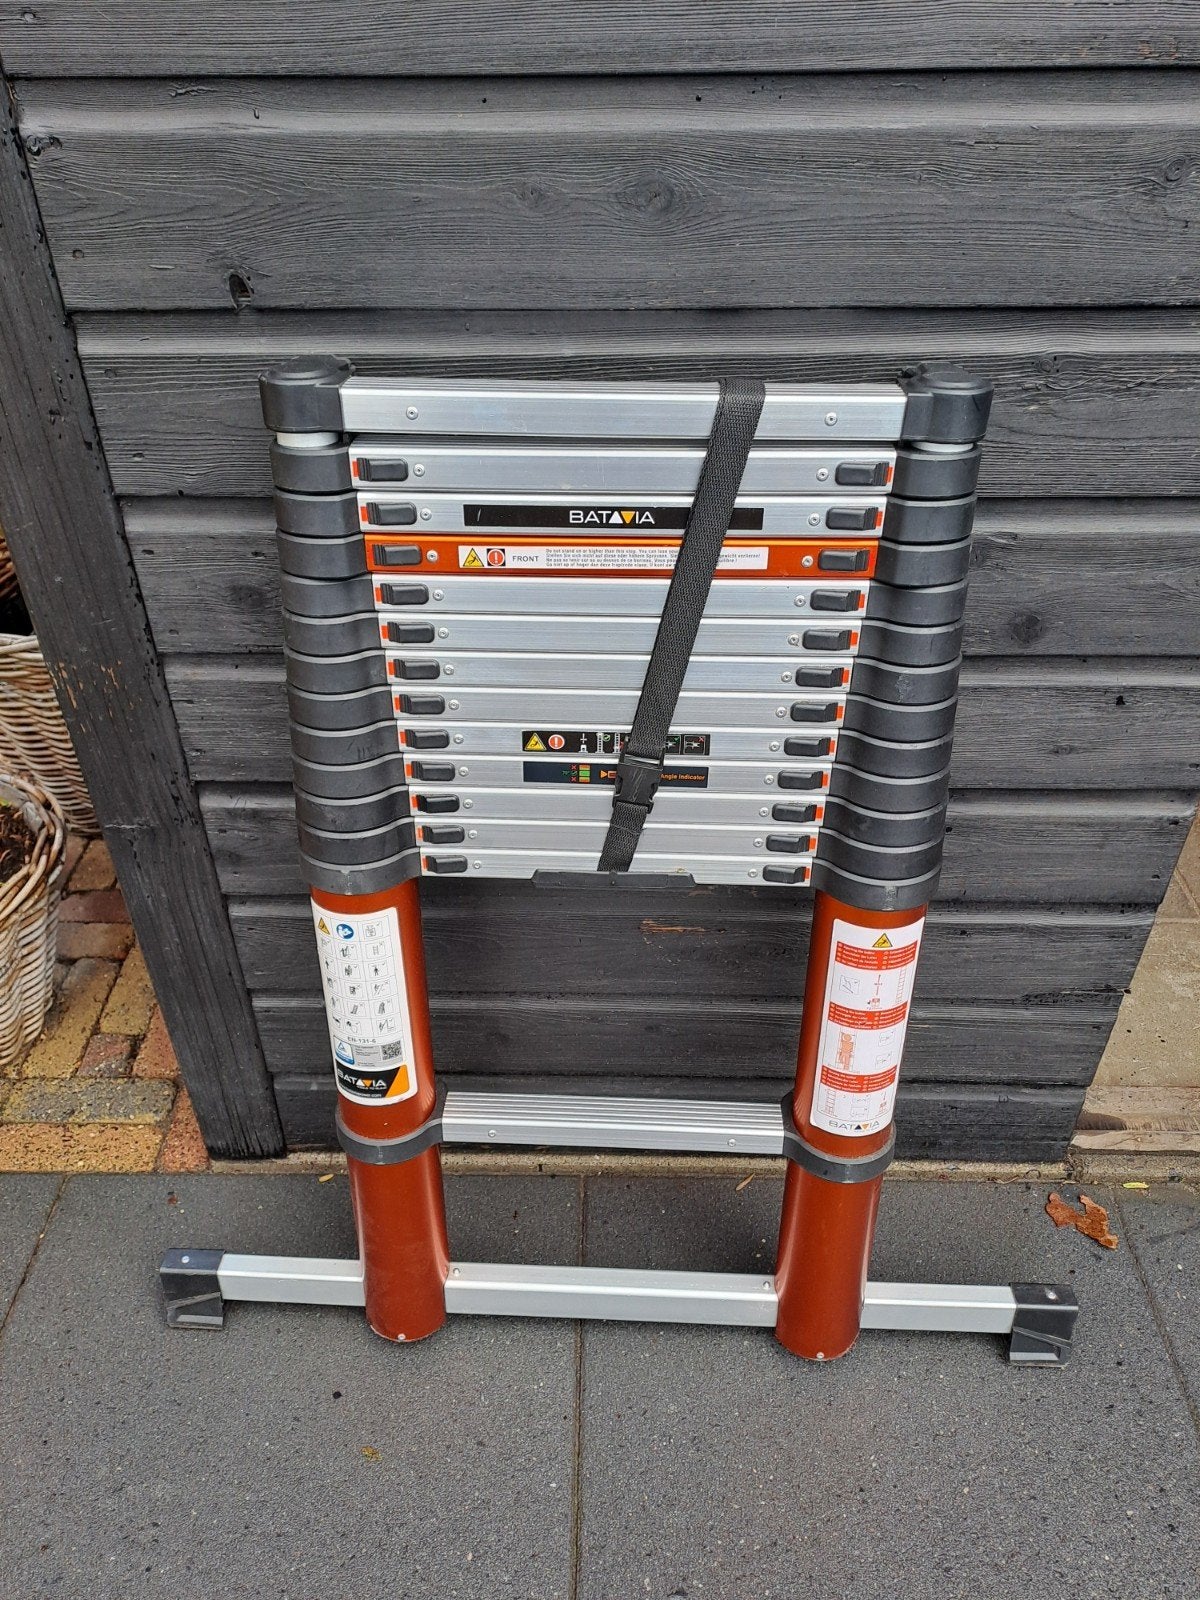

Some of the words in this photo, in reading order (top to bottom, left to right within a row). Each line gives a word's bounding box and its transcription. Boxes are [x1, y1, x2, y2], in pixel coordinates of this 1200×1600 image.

[569, 510, 655, 524] BATAVIA
[337, 1068, 387, 1087] BATAVIA
[828, 1120, 880, 1131] BATAVIA
